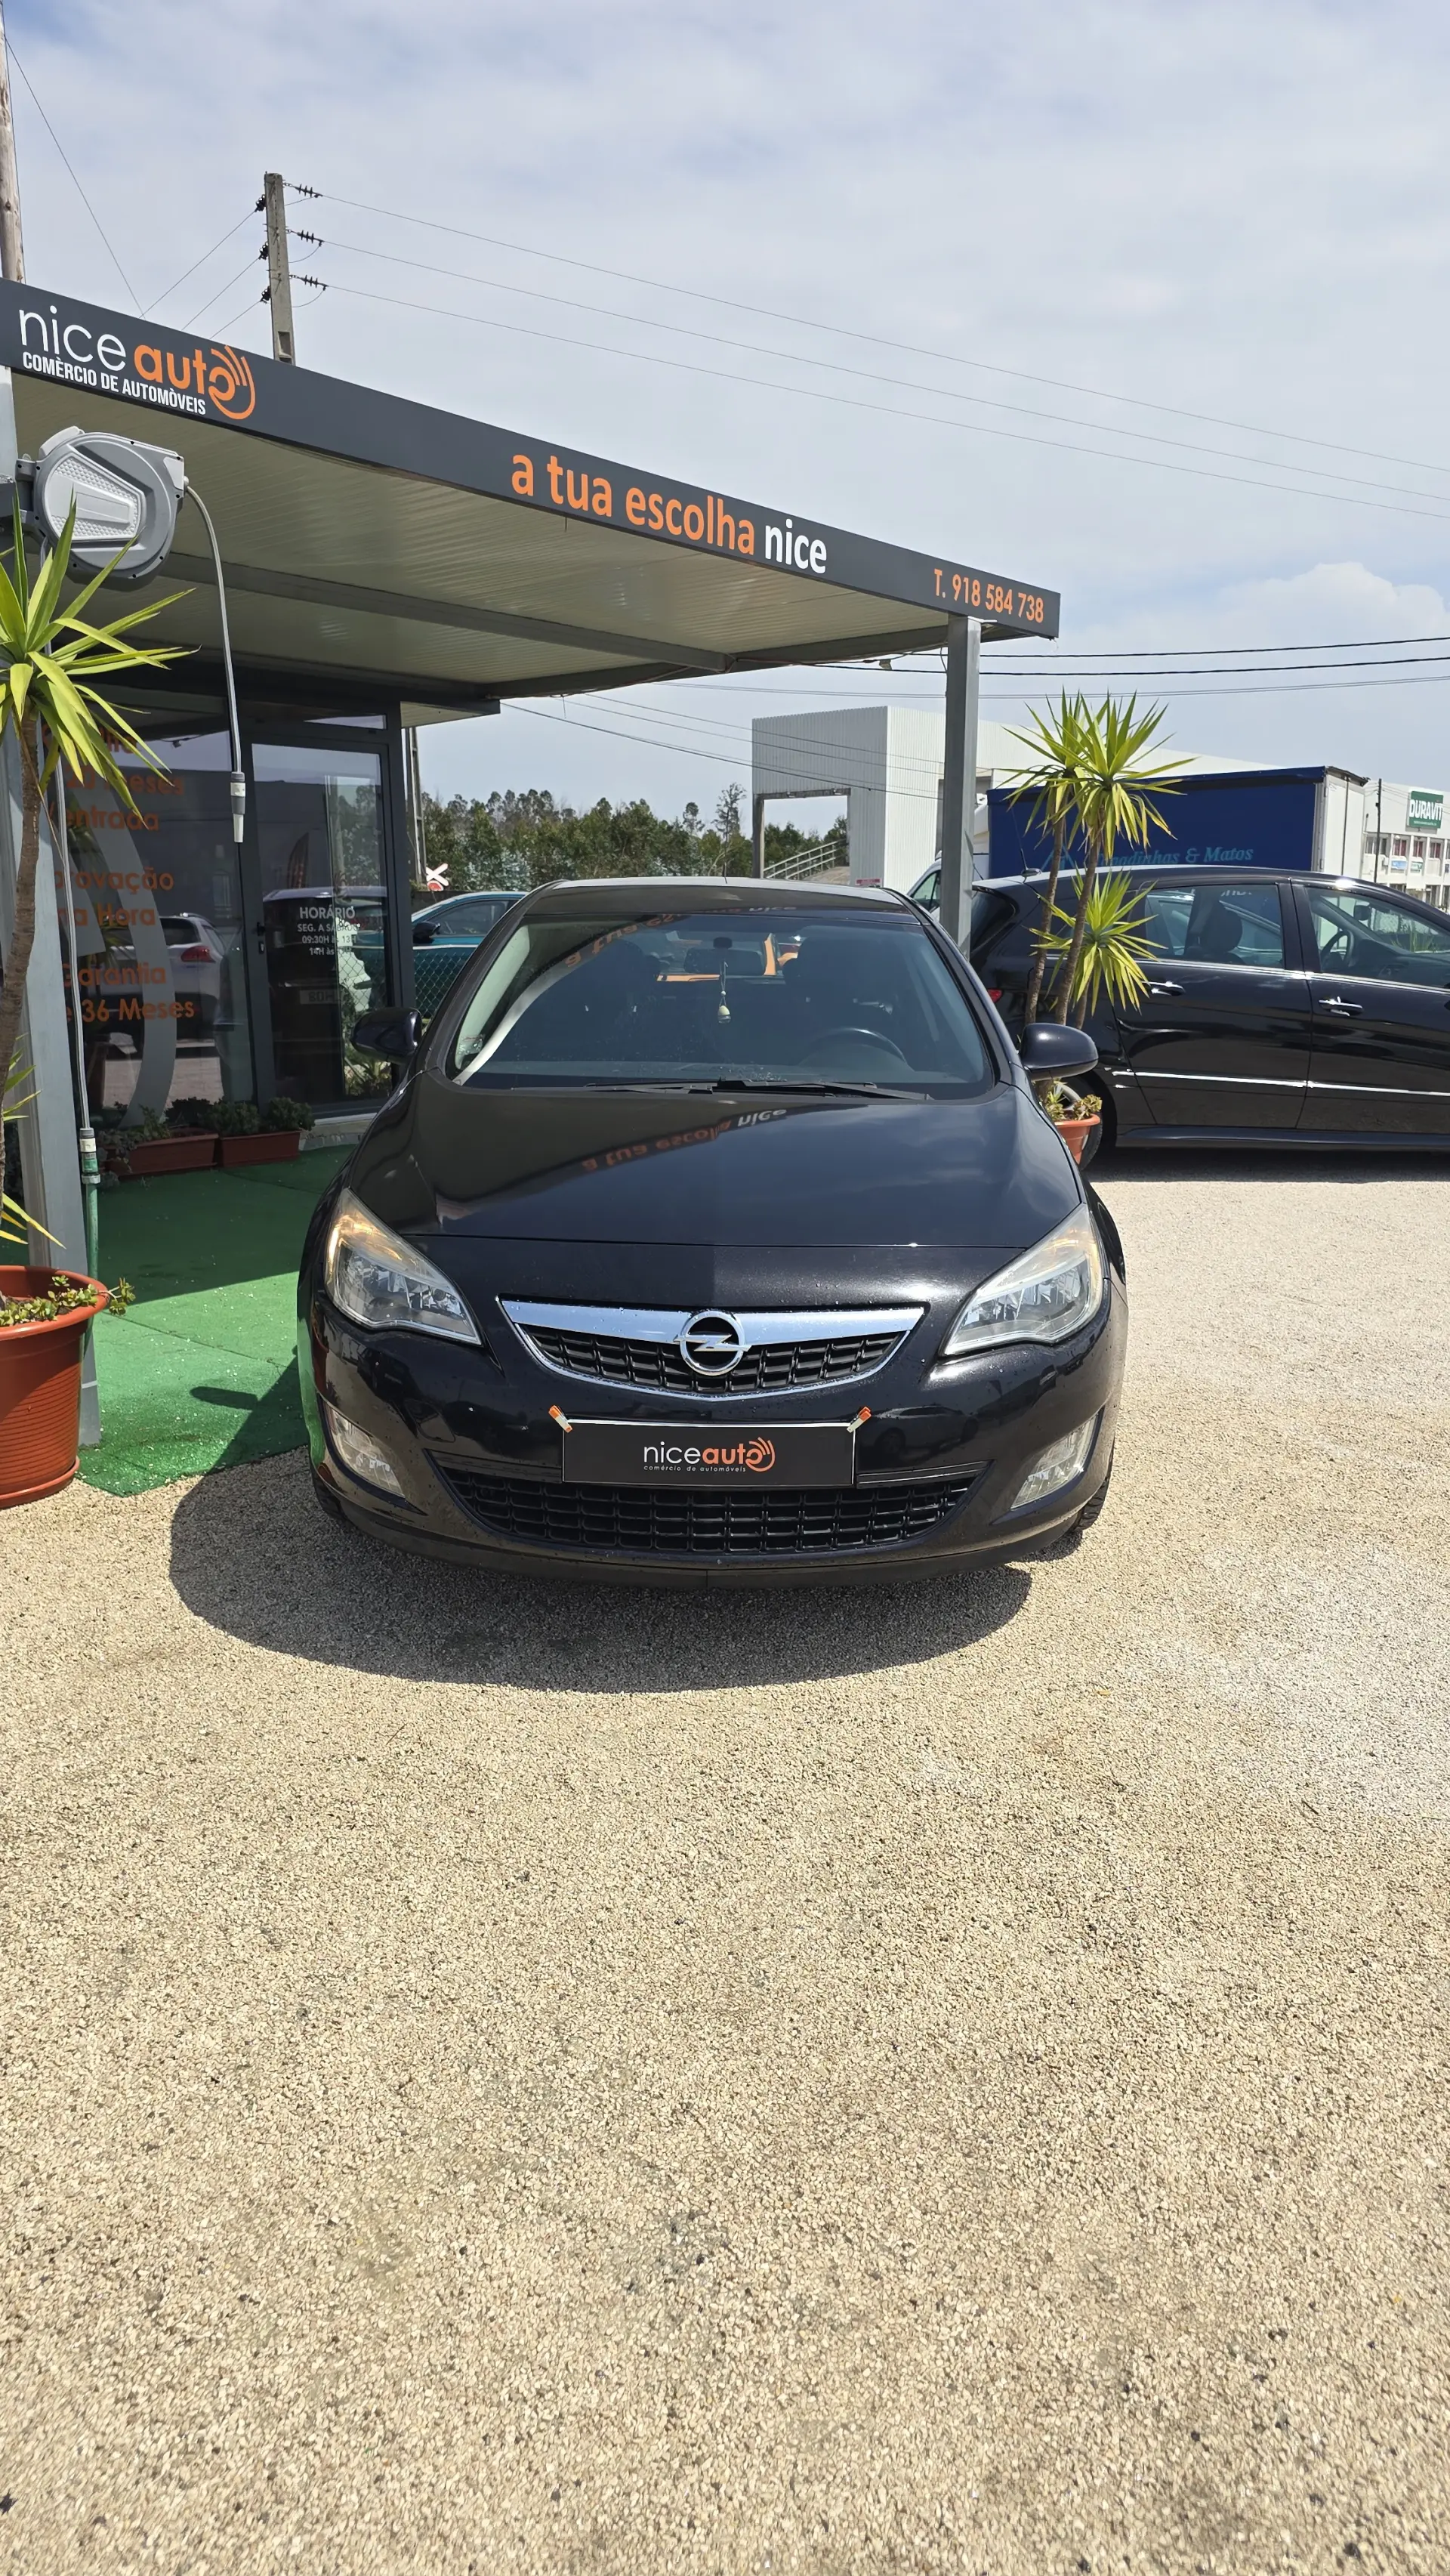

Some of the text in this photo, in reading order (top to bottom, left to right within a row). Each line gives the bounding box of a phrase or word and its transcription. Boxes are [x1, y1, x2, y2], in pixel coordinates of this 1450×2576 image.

[101, 372, 119, 392] DE
[511, 454, 827, 574] a tua escolha nice
[934, 568, 1044, 623] T. 918 584 738
[1409, 799, 1442, 821] DURAVIT
[1185, 848, 1200, 863] &
[1203, 846, 1254, 863] Matos
[97, 903, 156, 927] Hora
[299, 904, 356, 919] HORÁRIO
[297, 923, 316, 932] SEG.
[318, 923, 325, 931] A
[82, 999, 109, 1023] 36
[119, 998, 195, 1022] Meses
